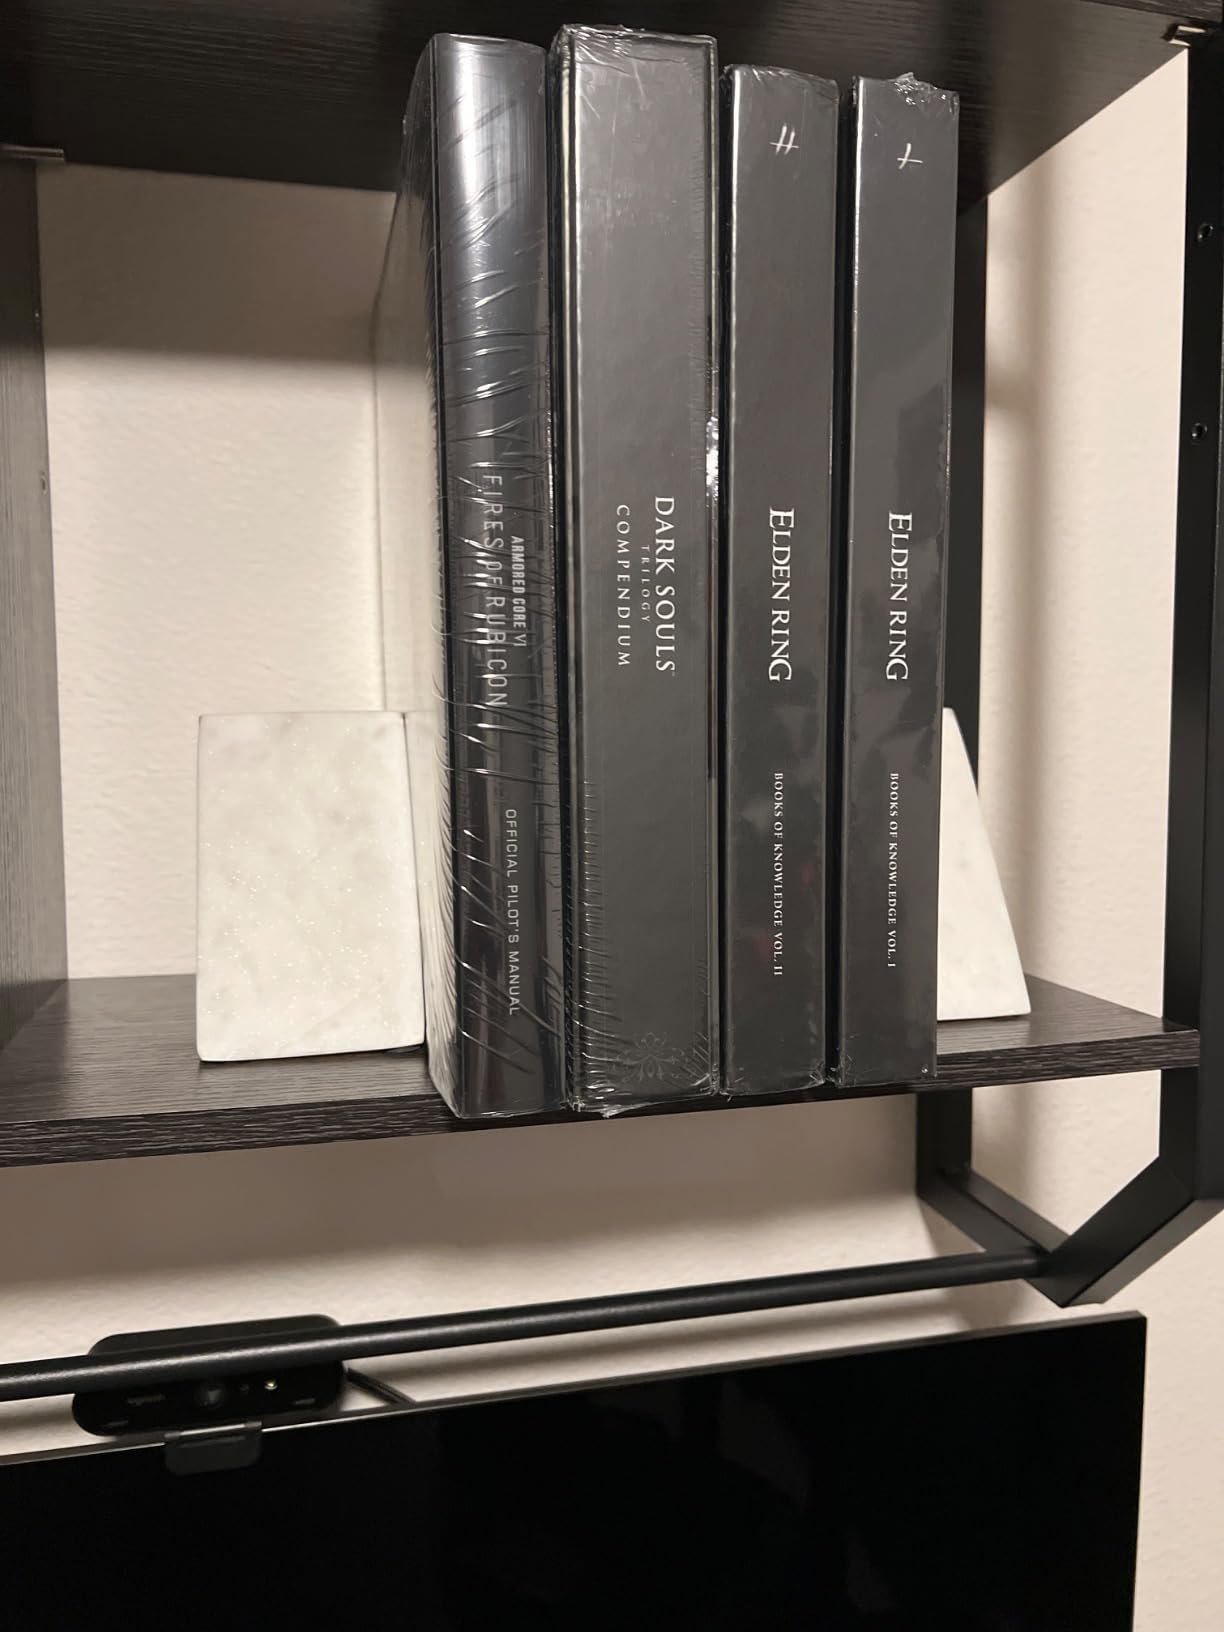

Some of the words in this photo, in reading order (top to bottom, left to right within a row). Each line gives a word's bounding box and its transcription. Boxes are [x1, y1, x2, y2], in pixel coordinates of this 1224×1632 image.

[483, 475, 504, 549] FIRES
[655, 496, 675, 575] DARK
[485, 562, 503, 584] OF
[512, 536, 525, 593] ARMORED
[616, 505, 631, 666] COMPENDIUM
[641, 545, 650, 623] TRILOGY
[769, 508, 795, 600] ELDEN
[887, 511, 913, 602] ELDEN
[512, 598, 526, 628] CORE
[513, 634, 527, 646] VI
[656, 585, 675, 671] SOULS
[768, 609, 792, 682] RING
[886, 610, 909, 680] RING
[486, 597, 507, 705] RUBICON
[773, 772, 784, 817] BOOKS
[889, 772, 900, 817] BOOKS
[505, 809, 518, 878] OFFICIAL
[773, 821, 784, 839] OF
[888, 821, 899, 838] OF
[507, 885, 519, 943] PILOT'S
[773, 843, 783, 927] KNOWLEDGE
[887, 843, 898, 924] KNOWLEDGE
[773, 932, 783, 962] VOL.
[773, 966, 783, 976] II
[887, 930, 897, 959] VOL.
[508, 952, 520, 1015] MANUAL
